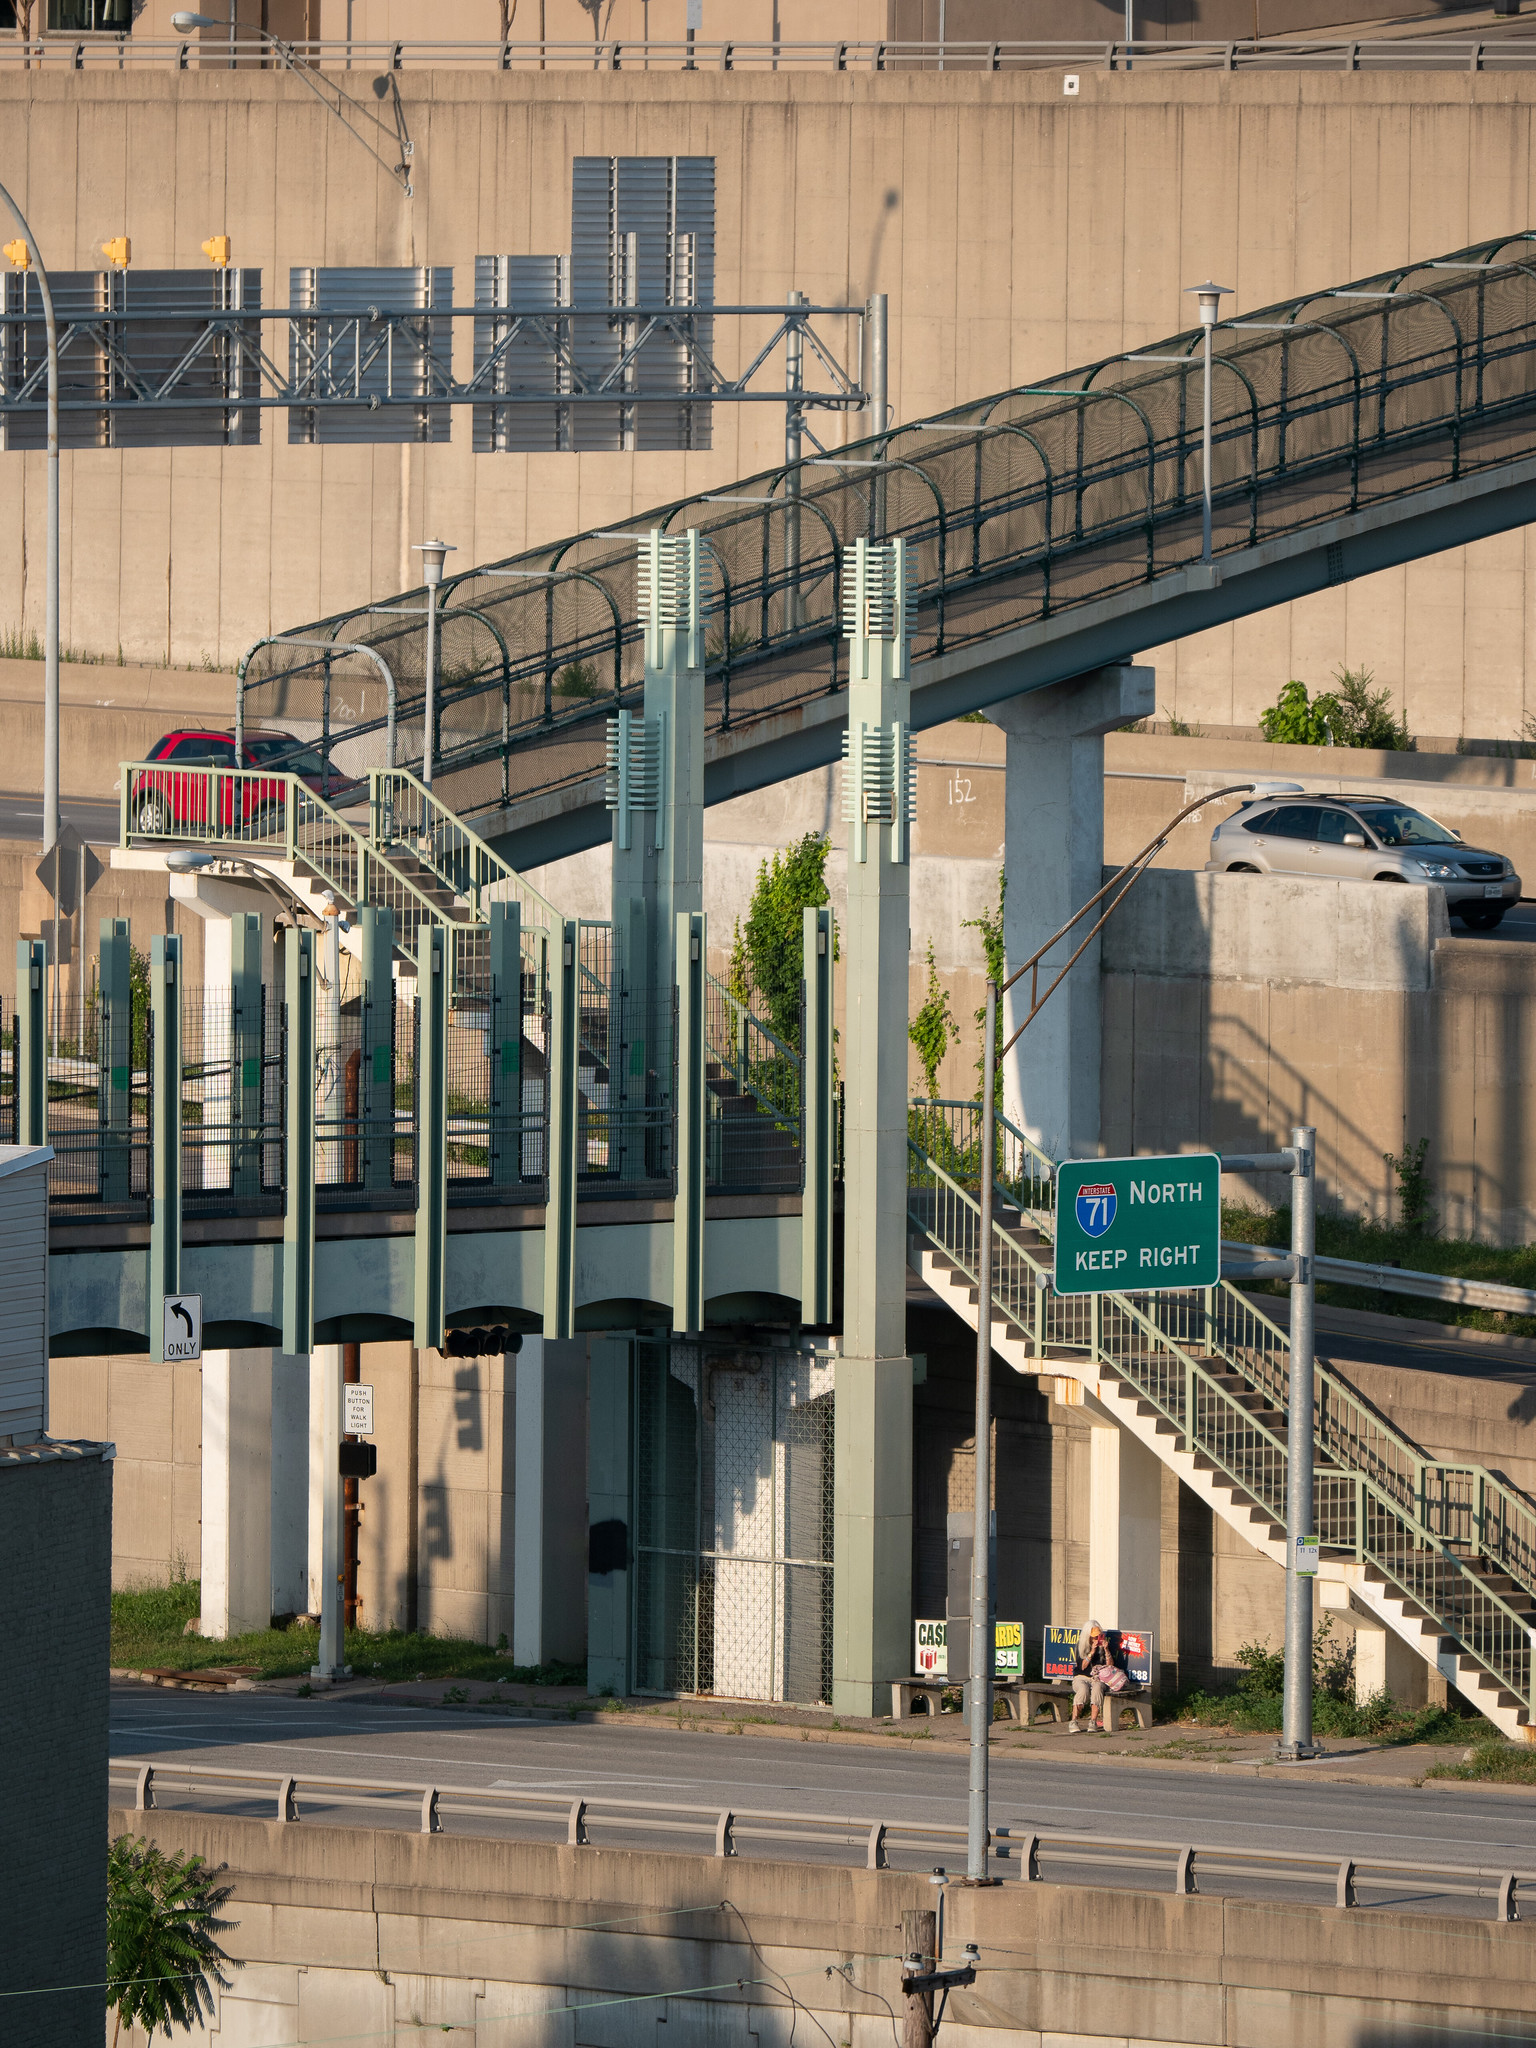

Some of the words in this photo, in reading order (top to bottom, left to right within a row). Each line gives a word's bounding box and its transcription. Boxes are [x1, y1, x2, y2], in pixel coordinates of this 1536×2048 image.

[949, 779, 977, 805] 152
[1082, 1187, 1111, 1195] INTERSTATE
[1130, 1180, 1202, 1205] NORTH
[1085, 1197, 1108, 1227] 71
[1076, 1249, 1128, 1271] KEEP
[1139, 1245, 1201, 1267] RIGHT
[168, 1341, 197, 1356] ONLY
[1050, 1628, 1062, 1644] We
[1062, 1629, 1081, 1645] Mak
[1046, 1663, 1074, 1675] EAGLE
